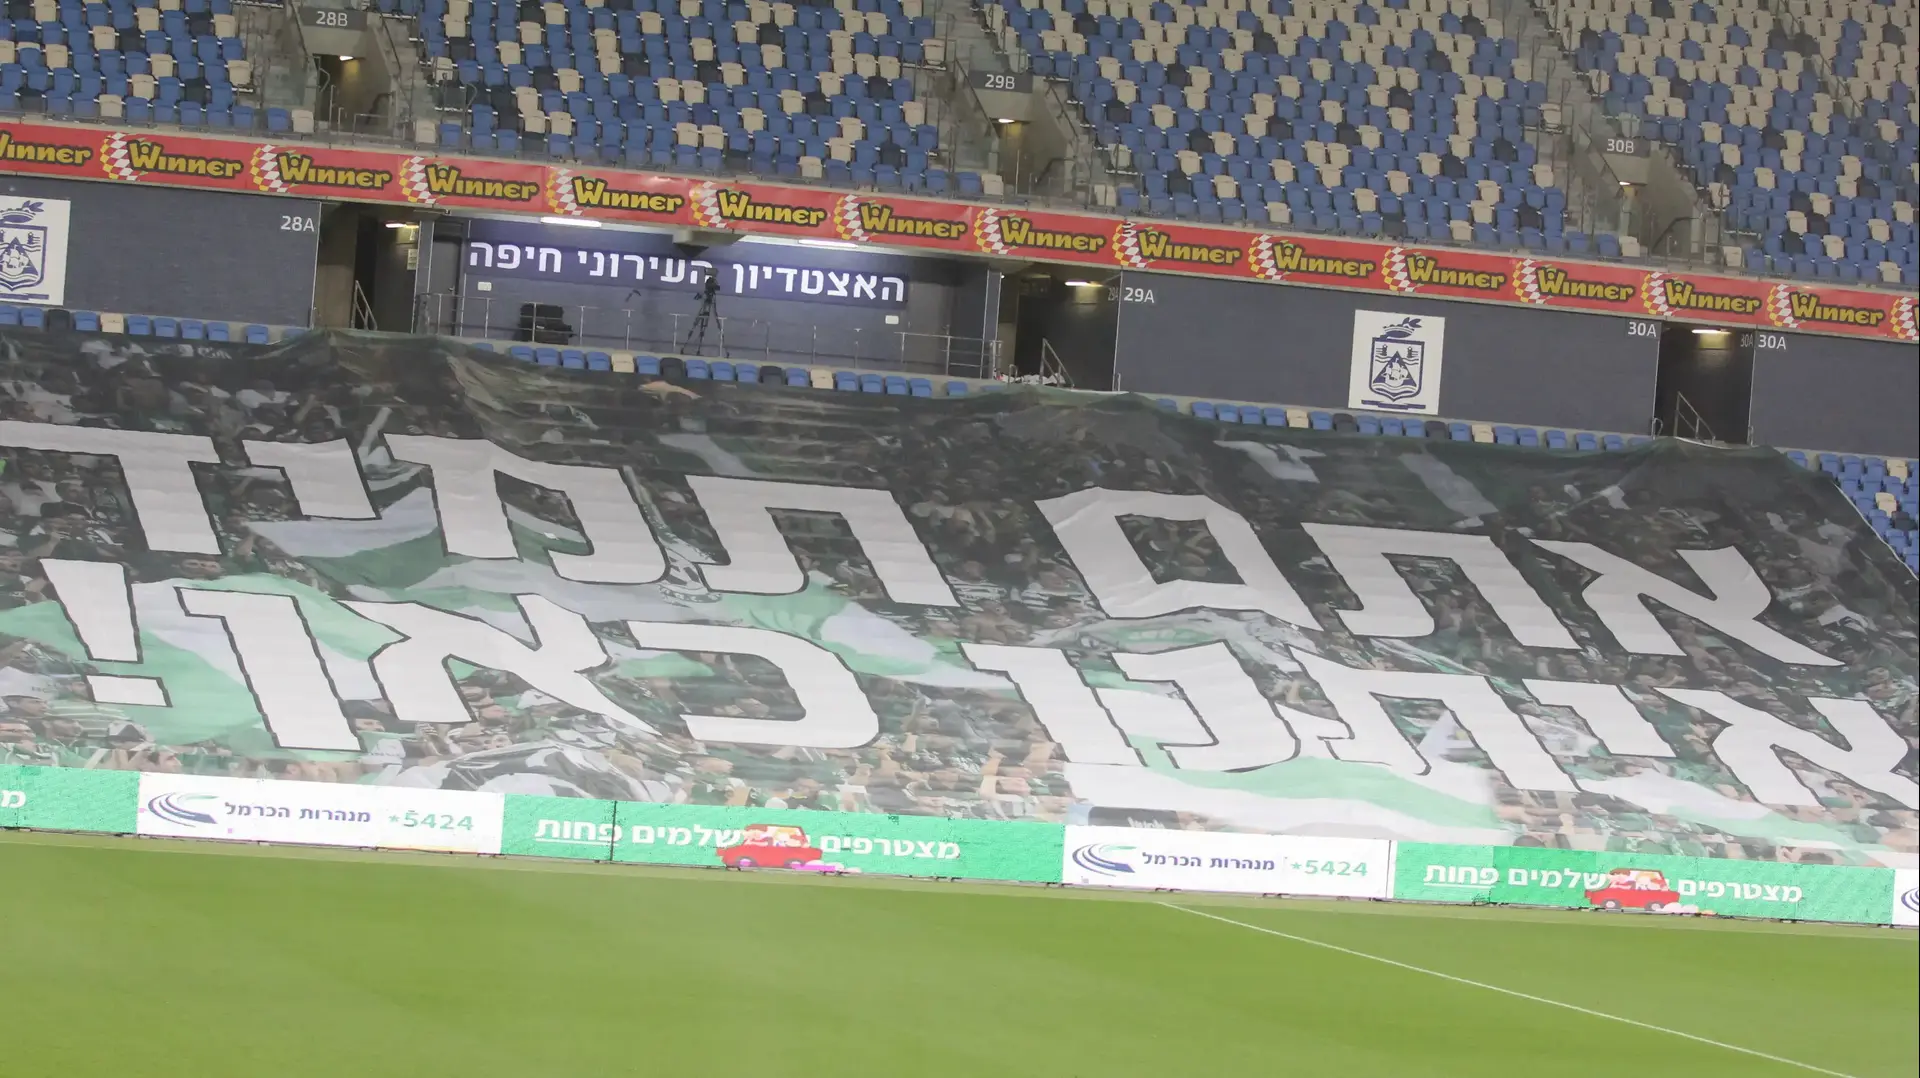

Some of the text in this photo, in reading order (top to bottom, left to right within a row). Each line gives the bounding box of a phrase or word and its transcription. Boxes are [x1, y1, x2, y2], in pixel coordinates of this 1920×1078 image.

[316, 11, 348, 27] 28B
[985, 73, 1015, 90] 29B
[127, 140, 243, 178] Winner
[1606, 138, 1634, 154] 30B
[277, 152, 392, 189] Winner
[425, 164, 540, 201] Winner
[571, 176, 684, 213] Winner
[716, 188, 827, 227] Winner
[280, 215, 315, 232] 28A
[859, 200, 967, 240] Winner
[998, 214, 1106, 254] Winner
[1136, 229, 1241, 266] Winner
[1272, 240, 1375, 278] Winner
[468, 241, 905, 302] האצטדיון העירוני חיפה
[1405, 254, 1506, 290] Winner
[1535, 266, 1635, 302] Winner
[1123, 286, 1155, 304] 29A
[1663, 278, 1762, 315] Winner
[1789, 291, 1885, 328] Winner
[1627, 321, 1657, 338] 30A
[1758, 334, 1787, 350] 30A
[0, 421, 1846, 667] אתם תמיד
[40, 557, 1919, 811] איתנו כאן!
[224, 801, 371, 823] מנהרות הכרמל
[534, 818, 622, 844] פחות
[820, 834, 960, 860] מצטרפים
[1142, 851, 1275, 871] מנהרות הכרמל
[1423, 864, 1500, 885] פחות
[1677, 878, 1803, 903] מצטרפים
